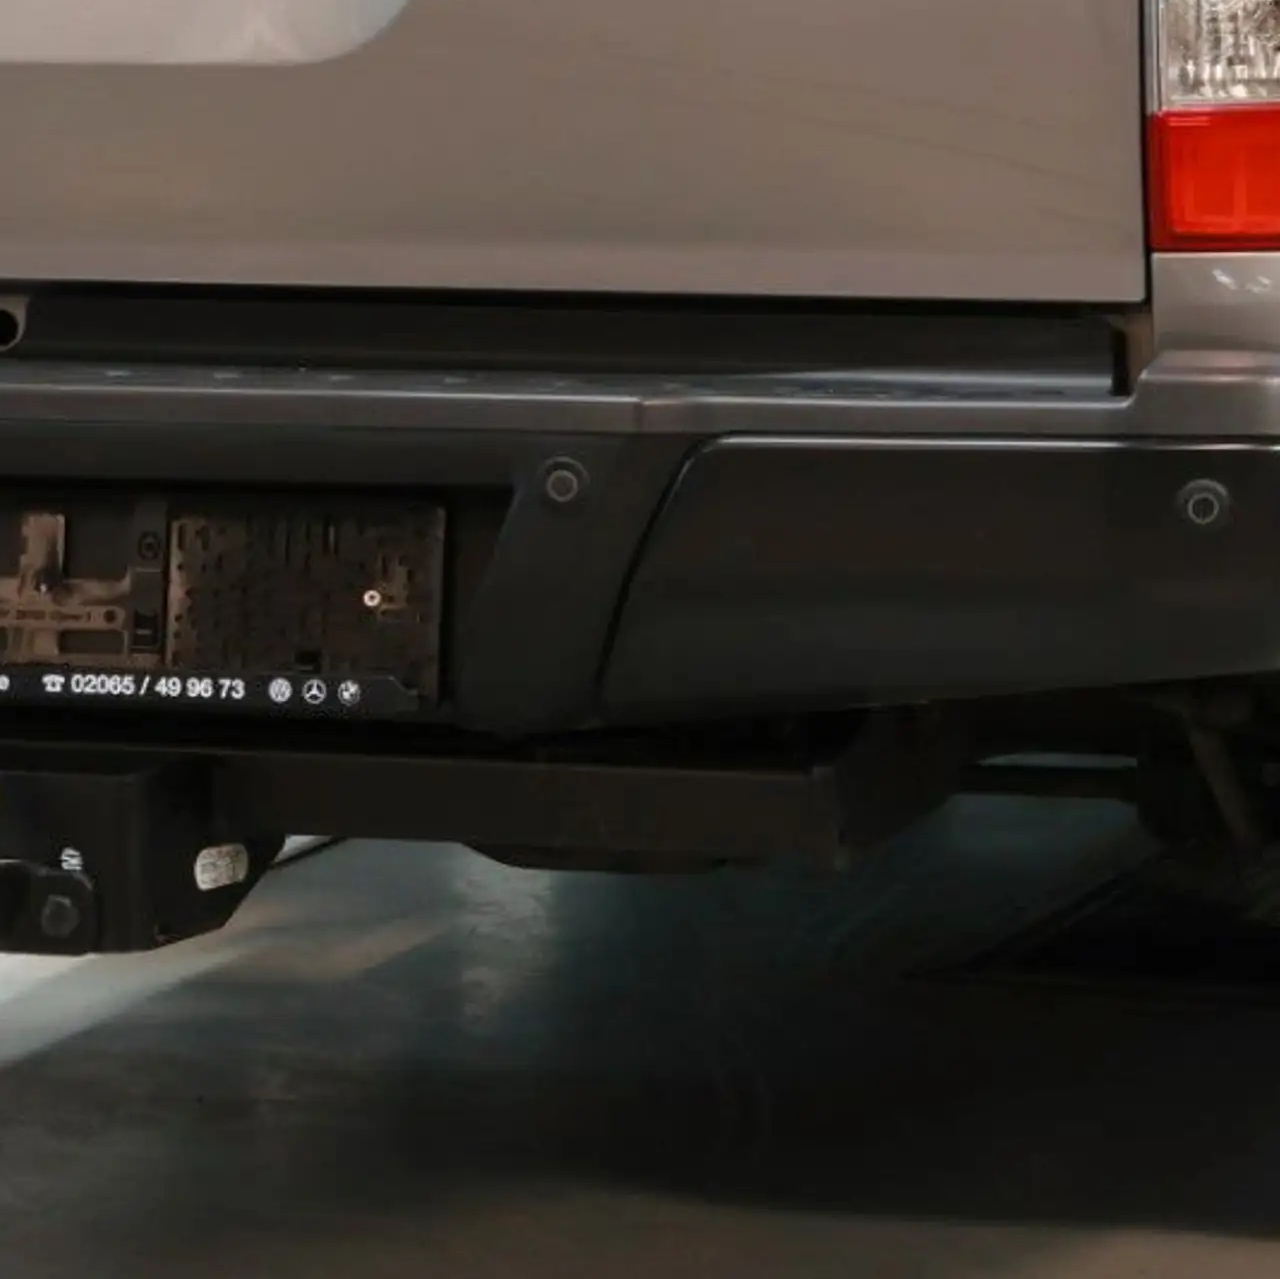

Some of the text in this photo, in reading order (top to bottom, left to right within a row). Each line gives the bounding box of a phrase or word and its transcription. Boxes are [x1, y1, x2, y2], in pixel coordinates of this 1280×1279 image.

[71, 673, 135, 695] 02065
[154, 677, 182, 697] 49
[186, 678, 214, 698] 96
[219, 678, 245, 699] 73
